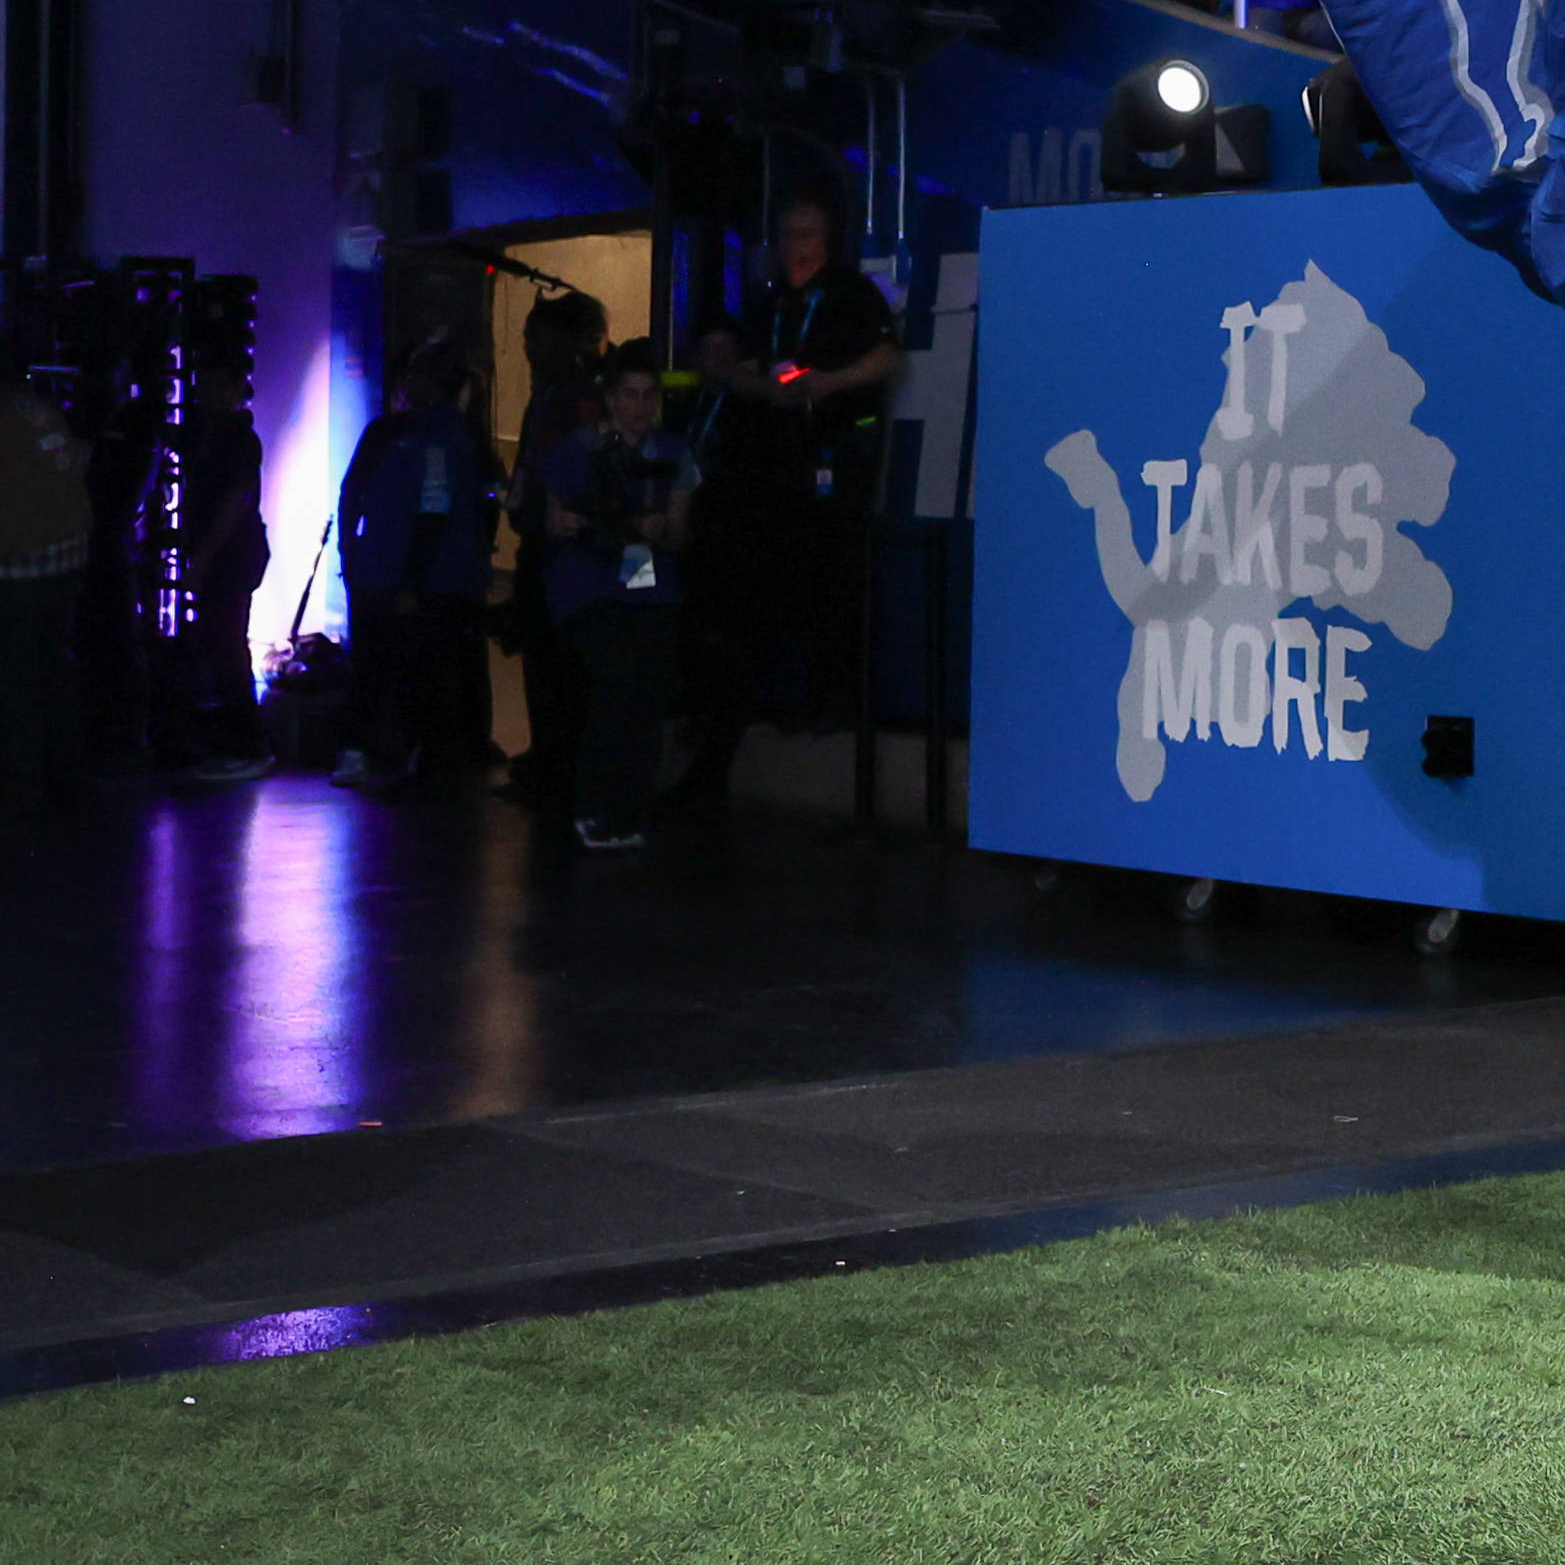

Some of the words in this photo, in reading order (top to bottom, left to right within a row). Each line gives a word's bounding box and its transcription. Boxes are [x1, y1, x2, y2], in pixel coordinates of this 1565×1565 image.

[1220, 301, 1305, 440] IT
[1140, 458, 1384, 597] TAKES
[1142, 617, 1372, 762] MORE
